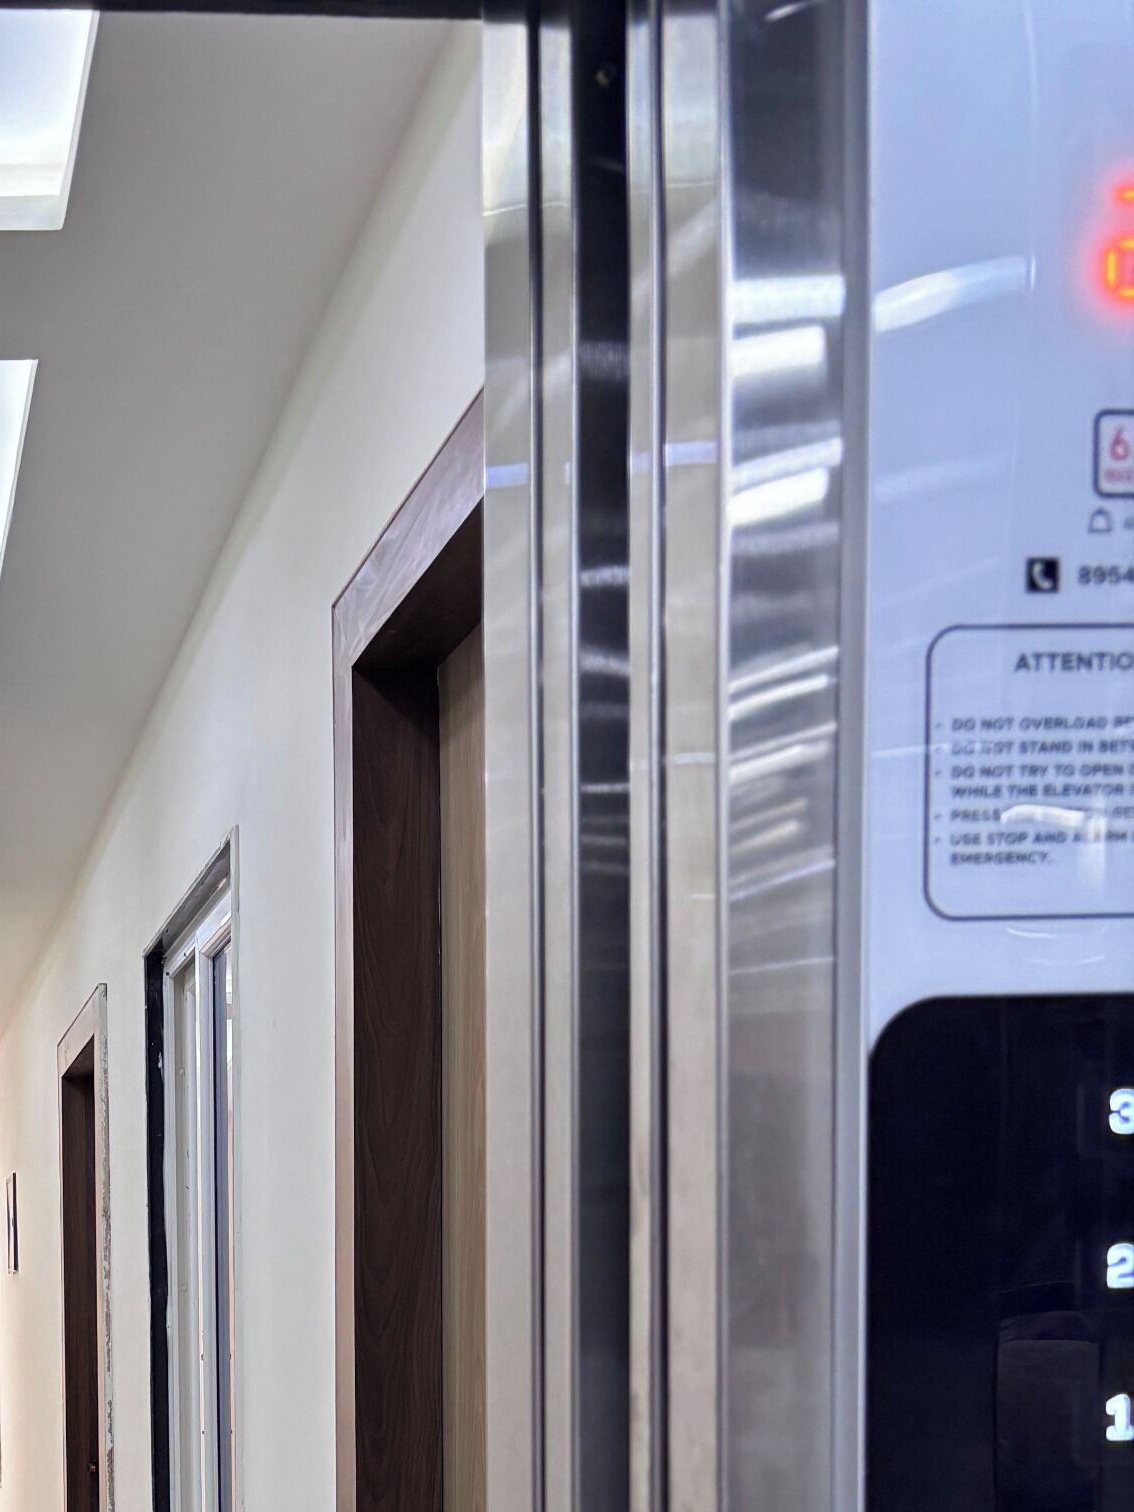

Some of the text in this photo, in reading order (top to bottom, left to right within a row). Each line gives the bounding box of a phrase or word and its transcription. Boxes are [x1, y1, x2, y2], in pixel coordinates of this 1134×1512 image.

[1110, 427, 1129, 462] 6
[951, 718, 976, 731] DO
[980, 718, 1014, 730] NOT
[1019, 717, 1107, 730] OVERLOAD
[951, 741, 975, 755] DO
[980, 741, 1013, 754] NOT
[1019, 740, 1072, 754] STAND
[1078, 740, 1093, 753] IN
[951, 766, 975, 779] DO
[980, 765, 1013, 778] NOT
[1018, 764, 1048, 778] TRY
[1055, 764, 1074, 776] TO
[1080, 764, 1123, 776] OPEN
[951, 785, 1002, 799] WHILE
[1008, 784, 1037, 797] THE
[1043, 784, 1123, 796] ELEVATOR
[951, 809, 1001, 821] PRESS
[950, 833, 981, 846] USE
[987, 832, 1027, 846] STOP
[1032, 832, 1066, 845] AND
[1073, 831, 1127, 842] AARM
[1109, 1088, 1134, 1134] 3
[1106, 1243, 1134, 1288] 2
[1106, 1393, 1134, 1441] 1
